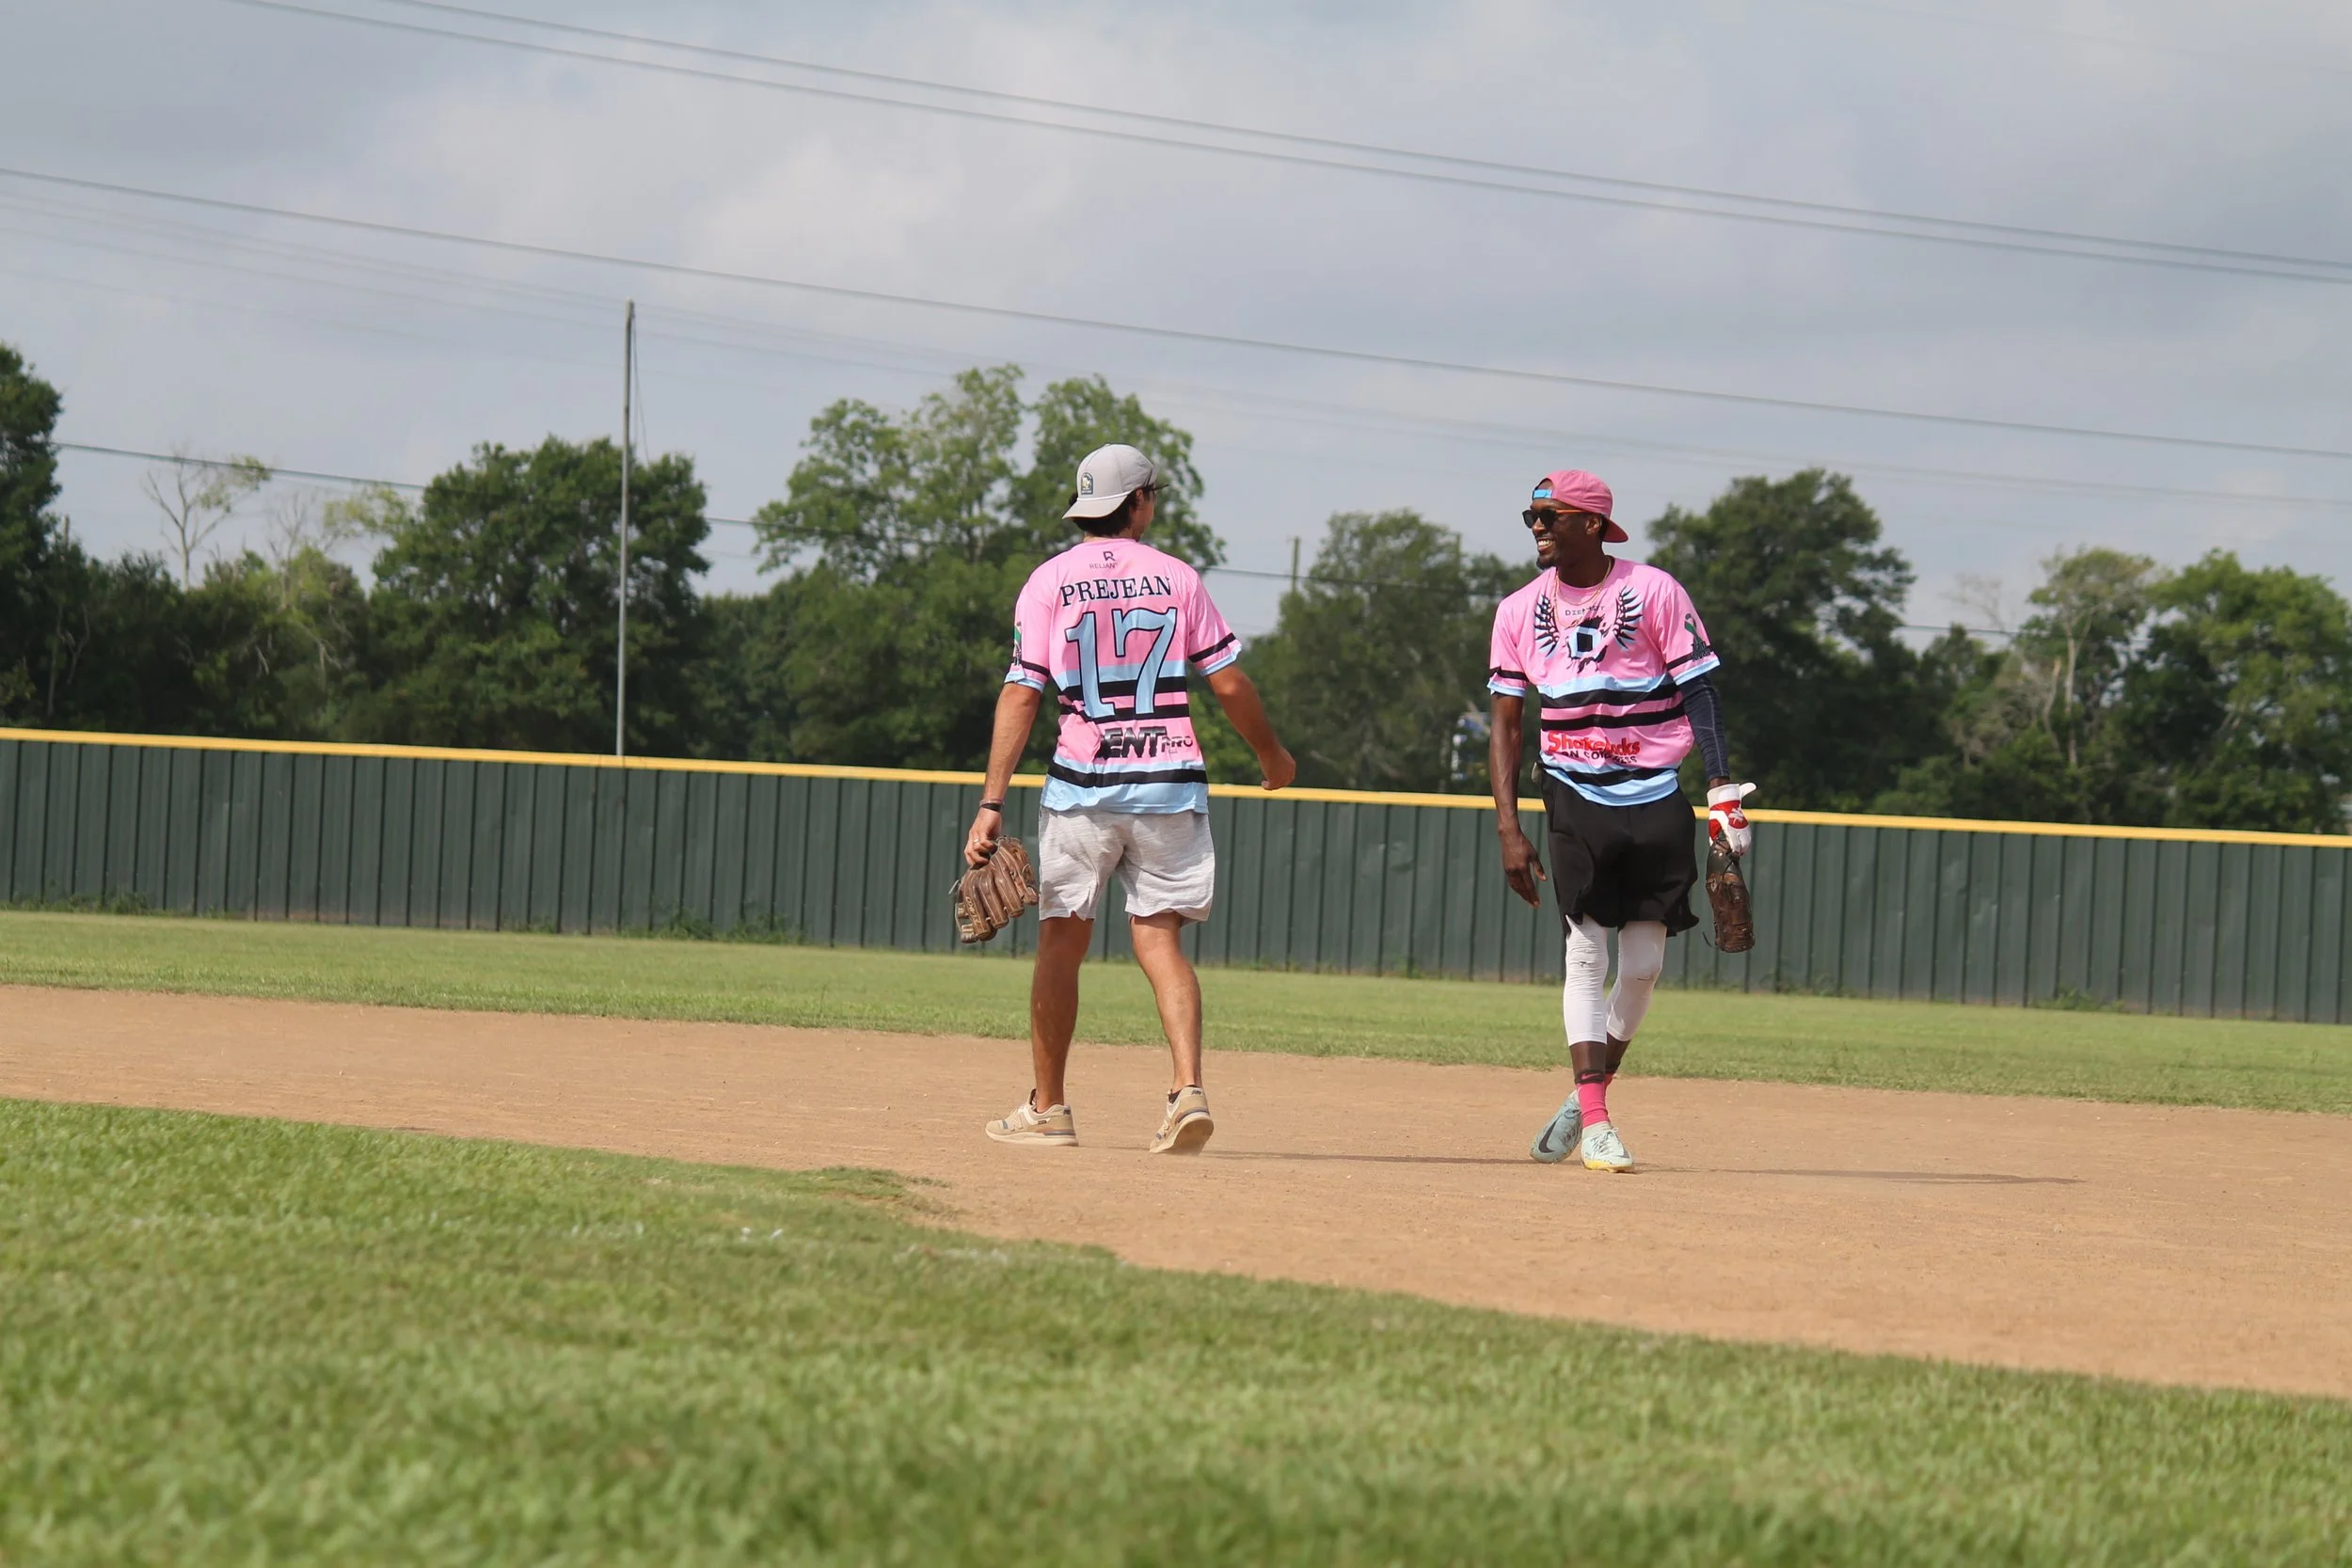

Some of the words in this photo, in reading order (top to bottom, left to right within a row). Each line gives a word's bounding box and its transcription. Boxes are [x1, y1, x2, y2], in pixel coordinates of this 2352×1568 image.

[1060, 576, 1170, 607] PREJEAN
[1065, 607, 1178, 720] 17
[1096, 726, 1167, 758] ENT
